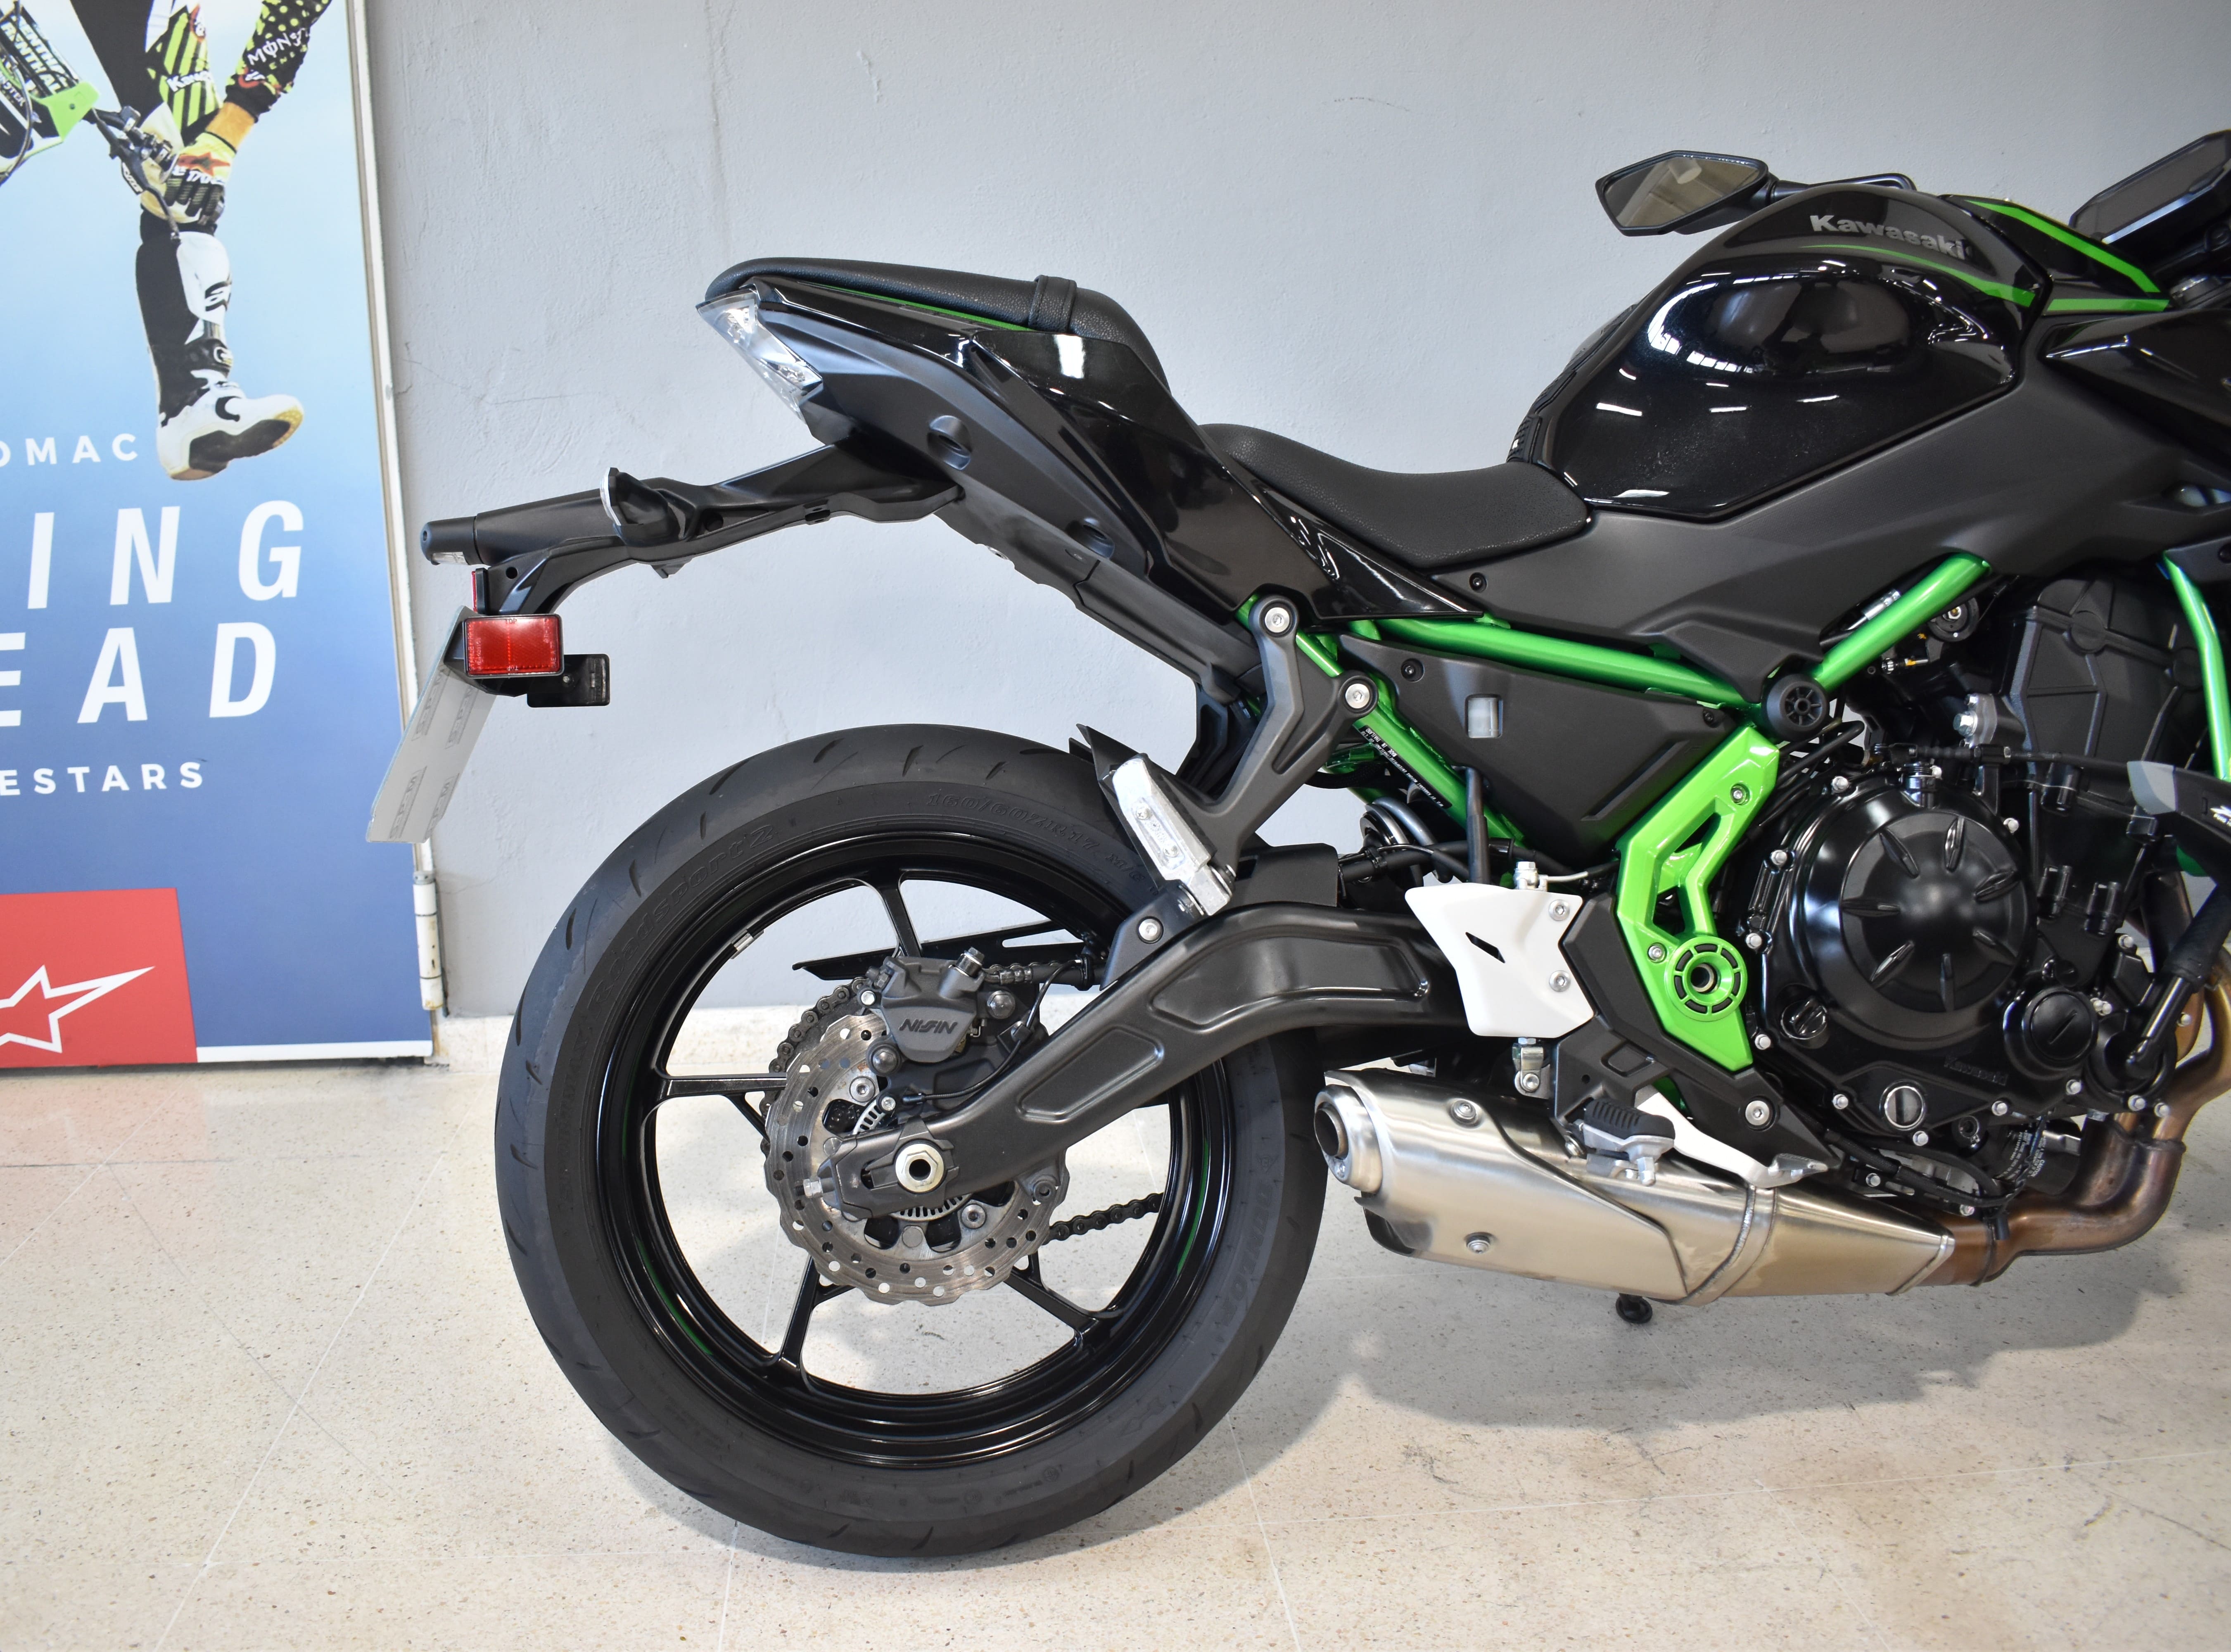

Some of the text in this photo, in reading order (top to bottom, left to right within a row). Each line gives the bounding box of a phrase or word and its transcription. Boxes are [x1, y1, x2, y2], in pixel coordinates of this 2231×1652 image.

[1809, 215, 1965, 260] Kawasaki
[28, 501, 303, 608] ING
[1365, 728, 1381, 743] THAILAND
[1388, 748, 1398, 757] MADE
[0, 762, 202, 795] ESTARS
[389, 775, 418, 839] S-P-M
[2030, 1159, 2045, 1177] CAUTION
